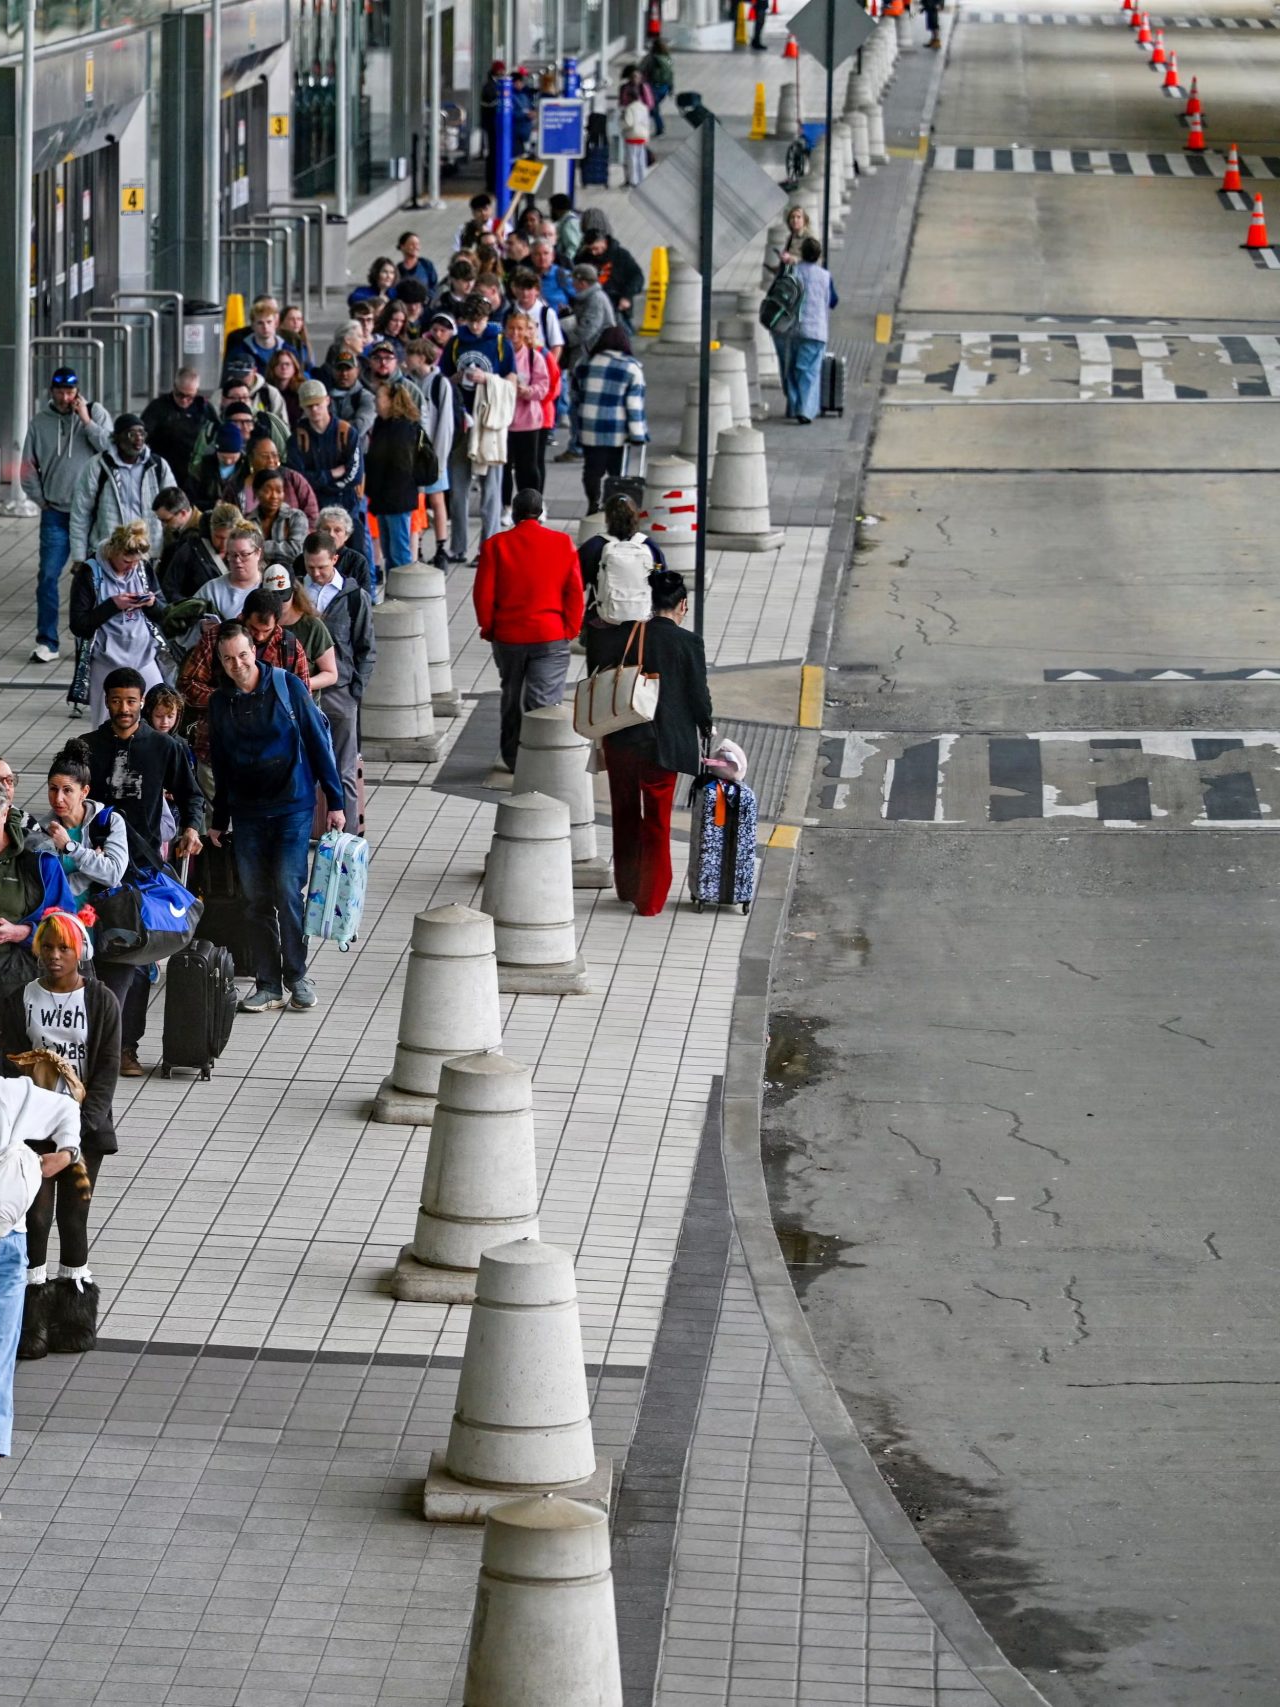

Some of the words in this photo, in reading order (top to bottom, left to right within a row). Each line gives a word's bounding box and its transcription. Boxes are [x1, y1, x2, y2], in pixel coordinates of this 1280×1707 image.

[274, 117, 282, 134] 3
[128, 190, 137, 208] 4
[28, 1004, 33, 1027] i
[41, 1004, 84, 1029] wish
[54, 1042, 85, 1059] was
